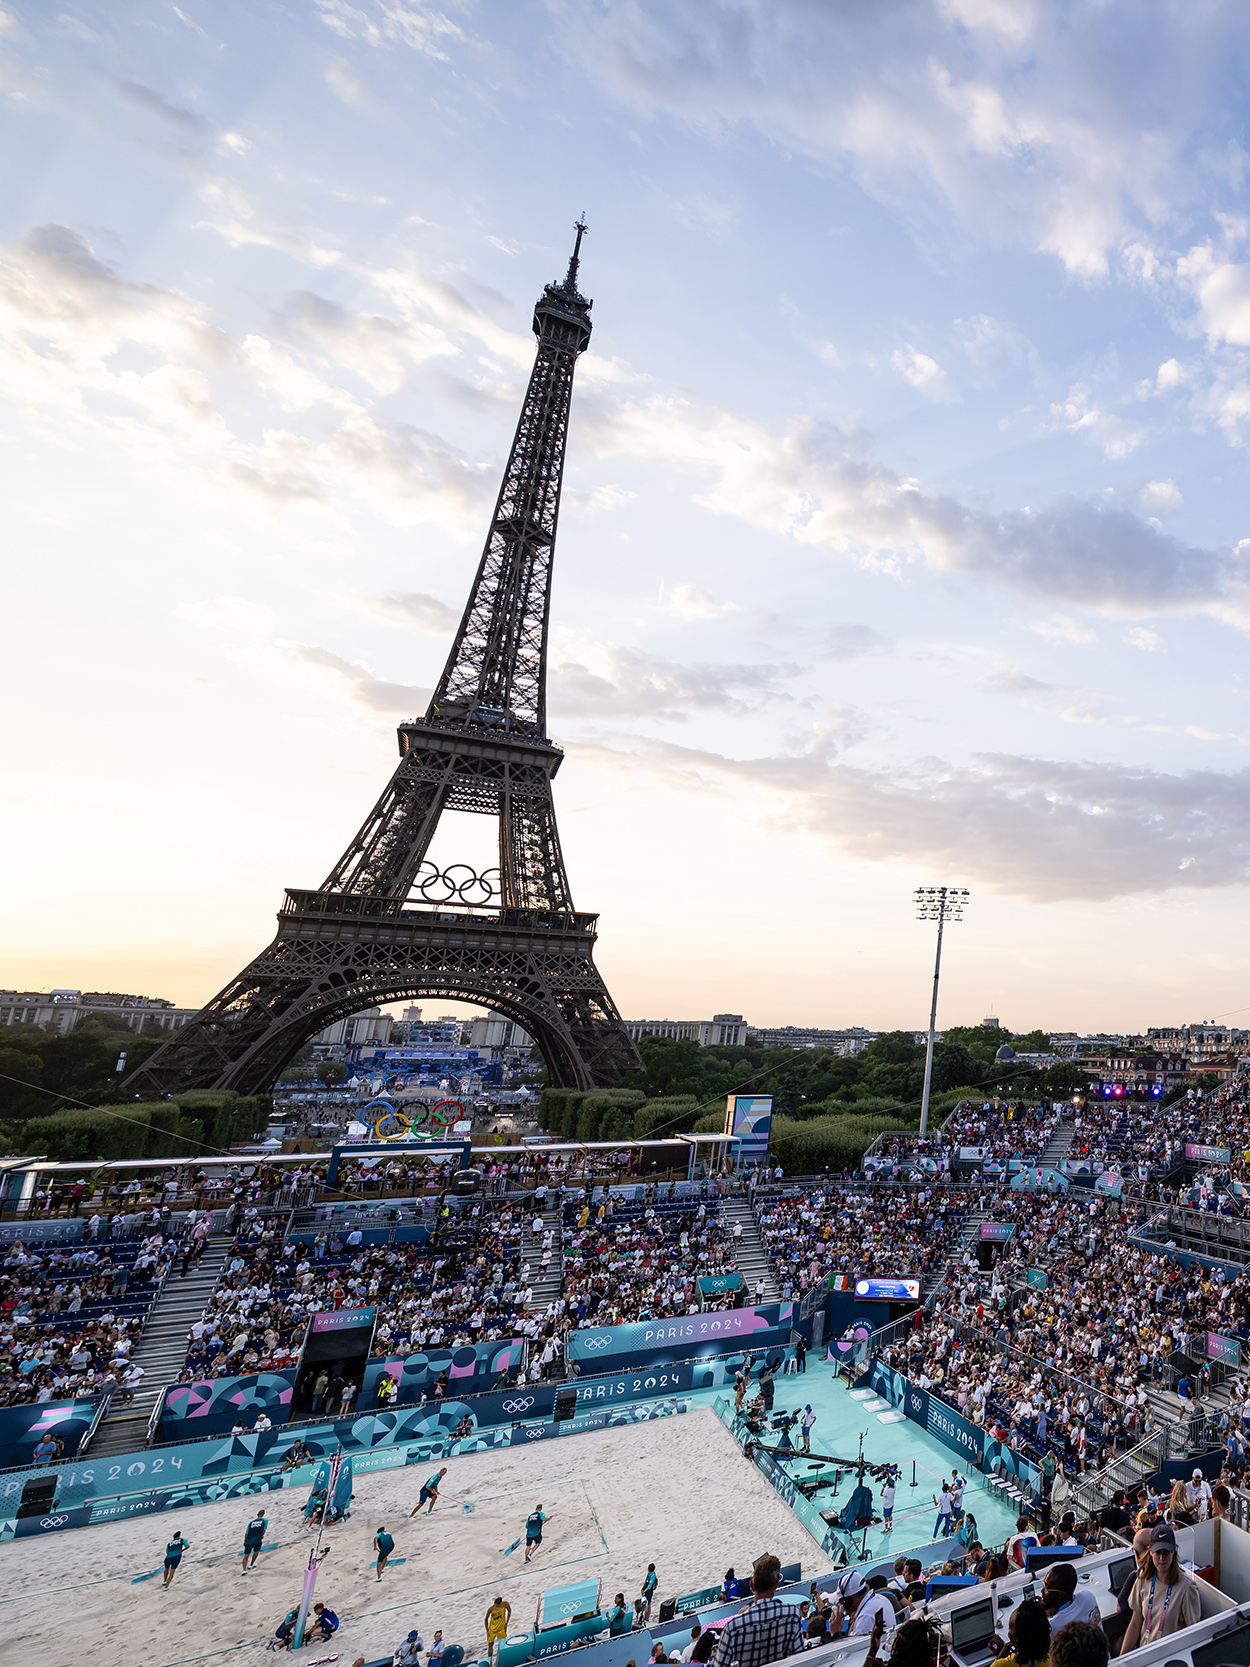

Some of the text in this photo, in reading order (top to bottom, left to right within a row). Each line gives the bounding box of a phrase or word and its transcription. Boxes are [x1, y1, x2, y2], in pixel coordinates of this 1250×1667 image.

[700, 1318, 742, 1333] 2024
[632, 1373, 679, 1392] 2024
[956, 1428, 978, 1454] 2024
[107, 1456, 183, 1481] 2024
